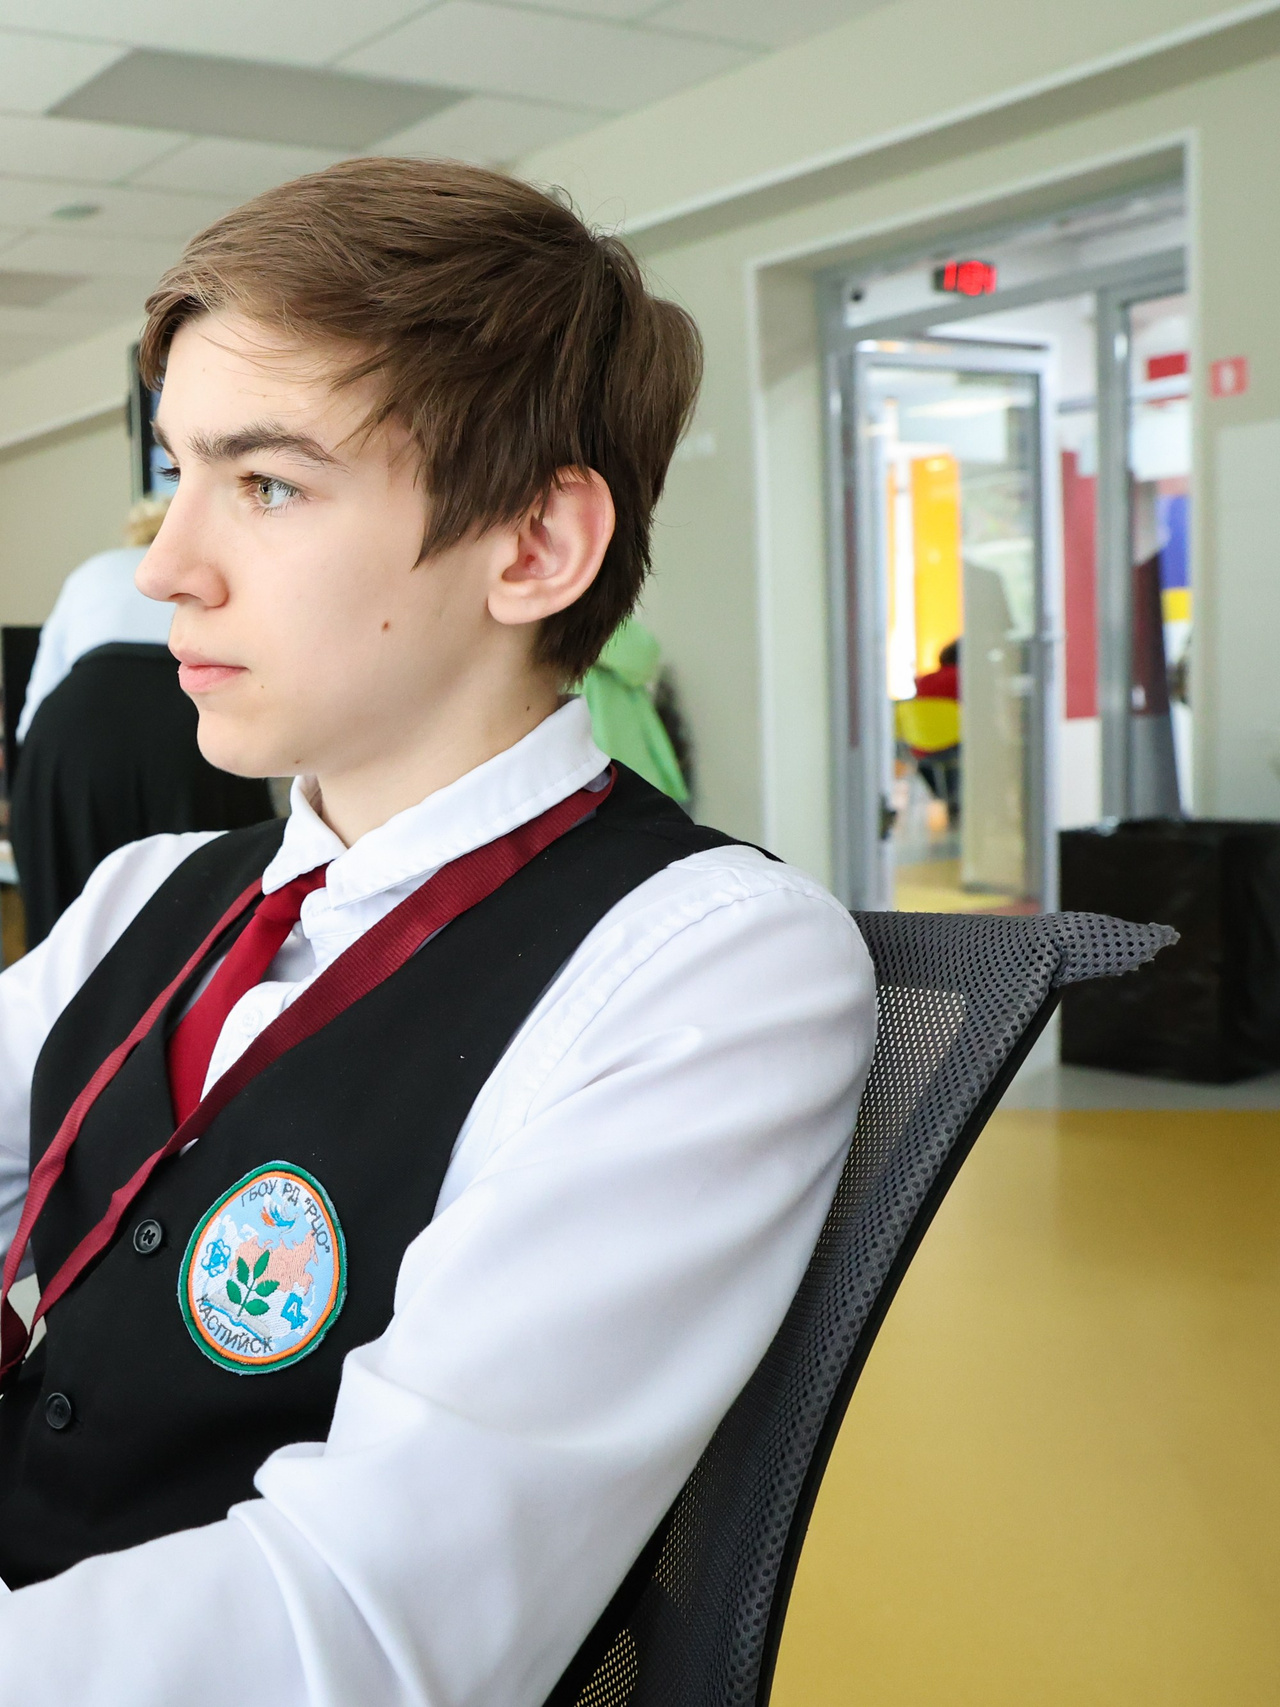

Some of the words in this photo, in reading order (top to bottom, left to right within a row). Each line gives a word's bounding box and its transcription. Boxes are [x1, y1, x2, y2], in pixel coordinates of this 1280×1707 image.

[241, 1179, 278, 1207] ГБОУ
[282, 1182, 301, 1207] РД
[196, 1294, 274, 1354] КАСПИЙСК
